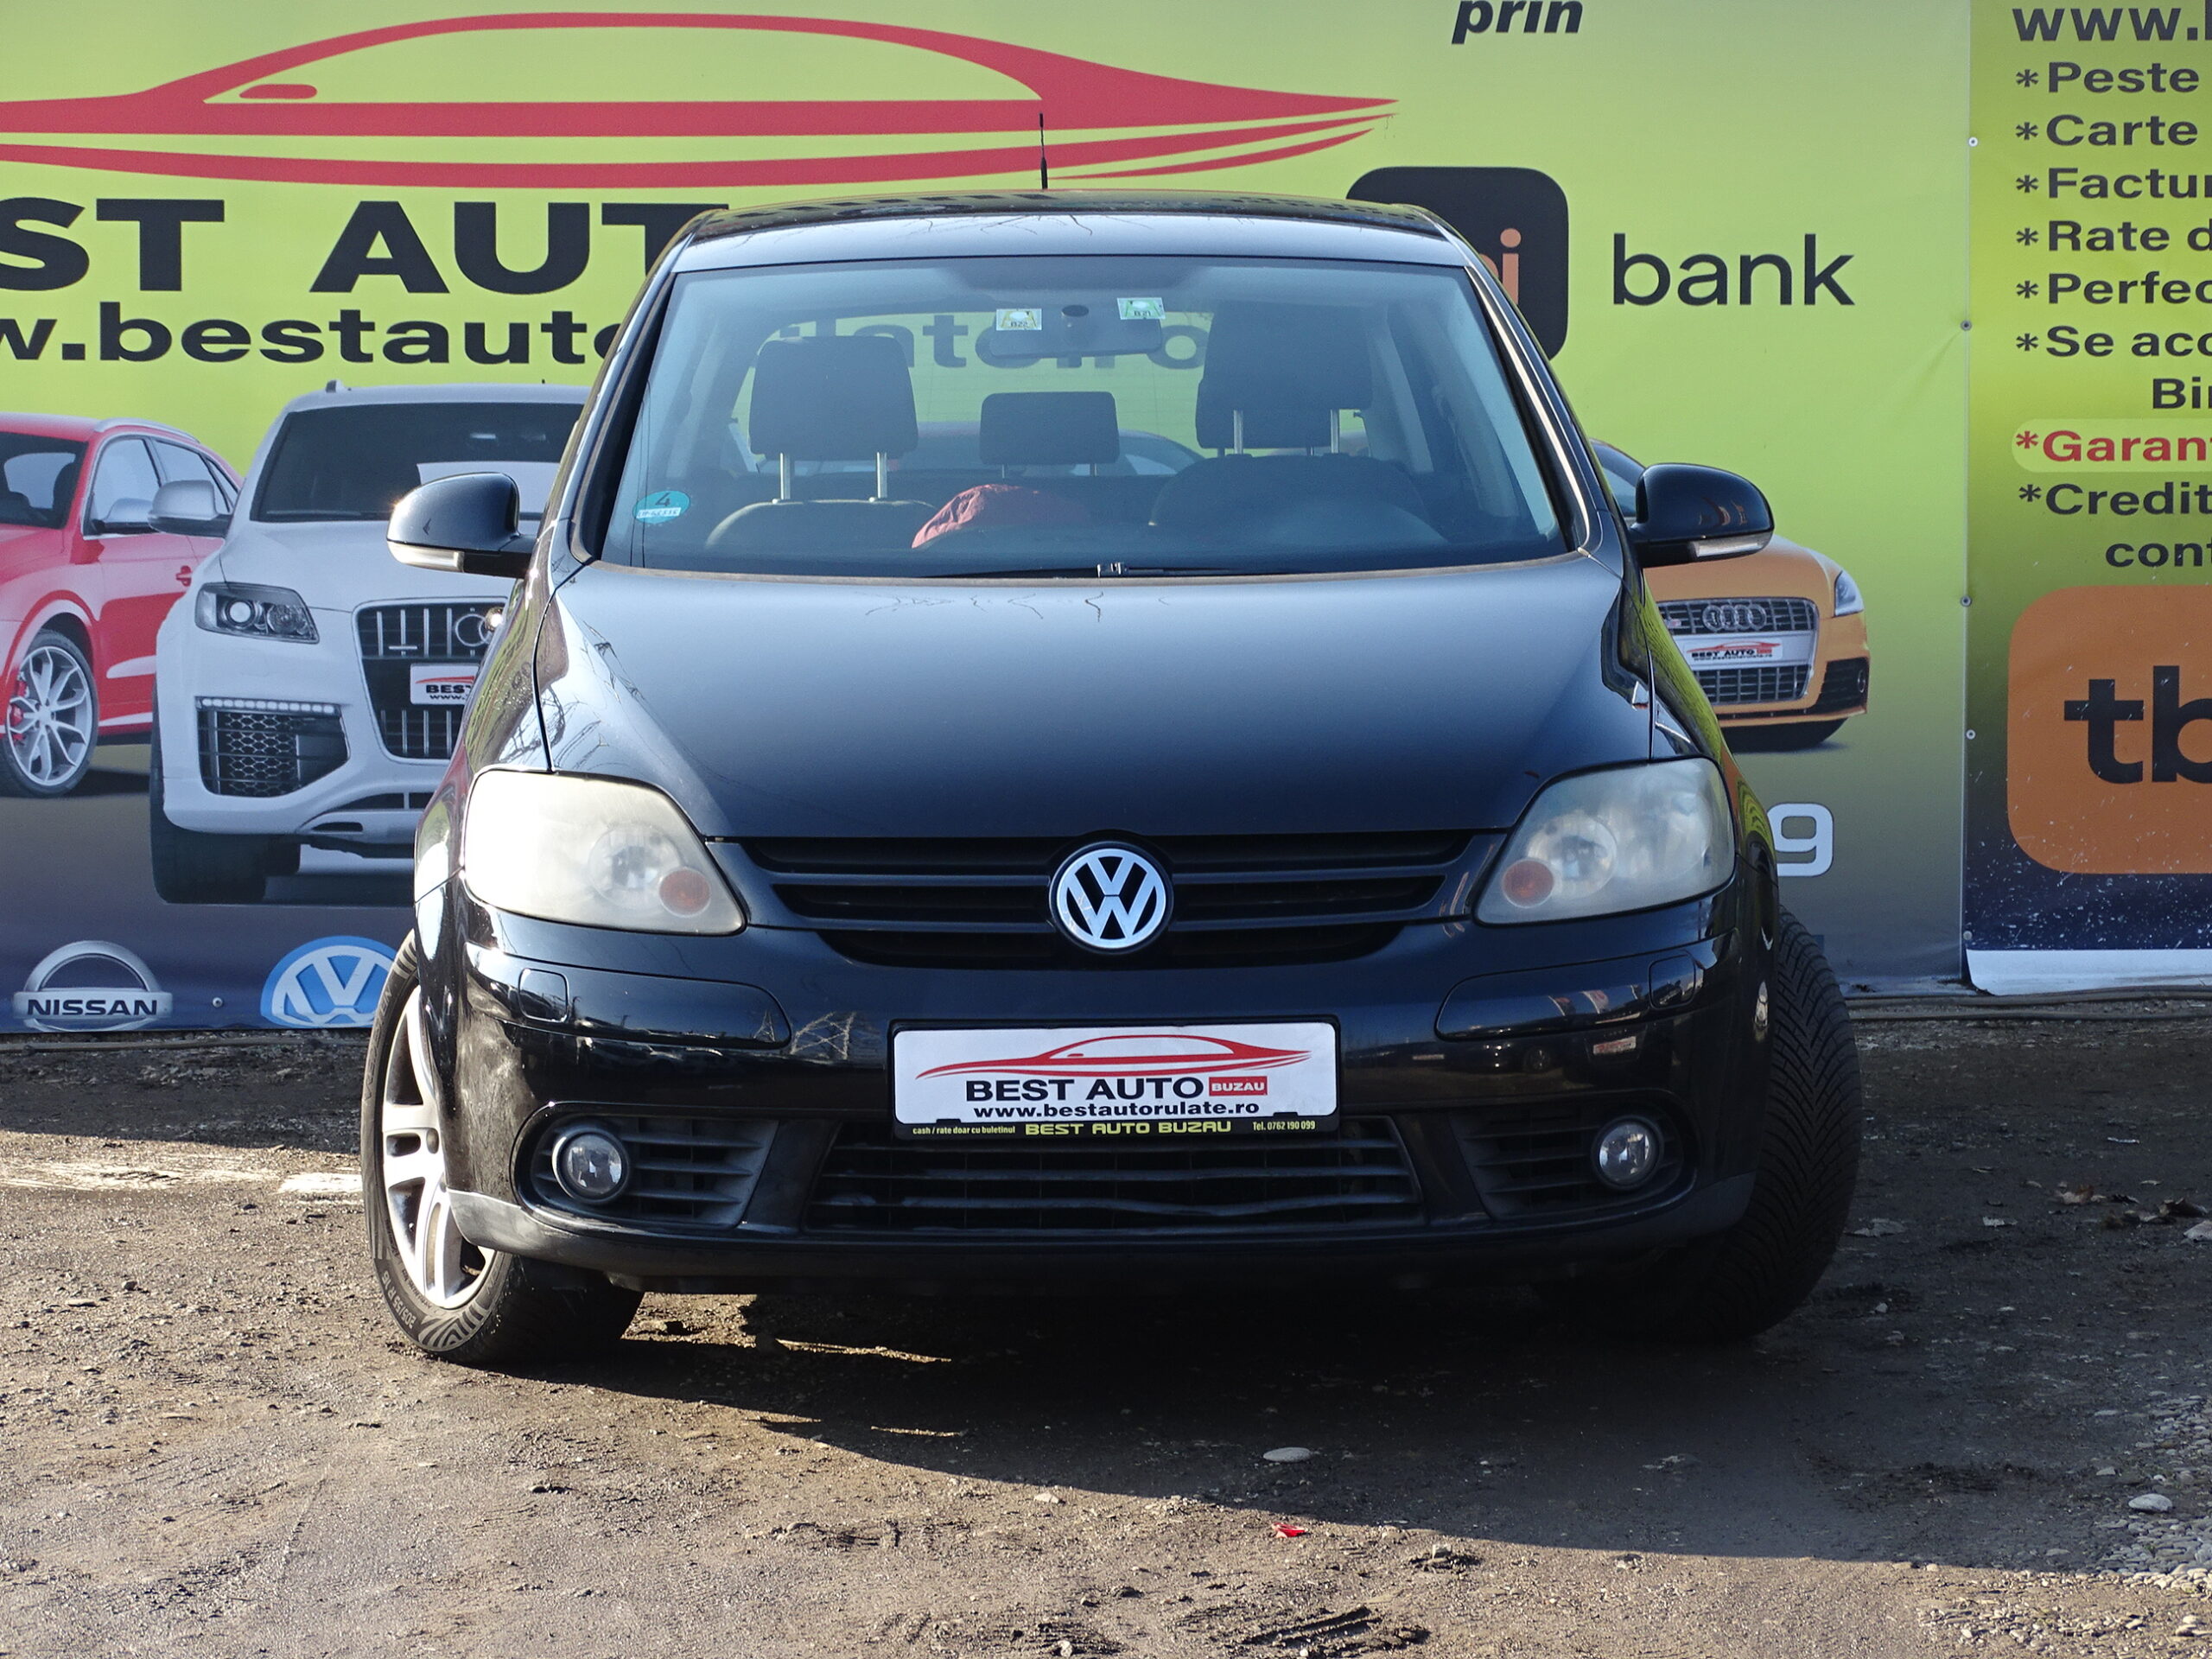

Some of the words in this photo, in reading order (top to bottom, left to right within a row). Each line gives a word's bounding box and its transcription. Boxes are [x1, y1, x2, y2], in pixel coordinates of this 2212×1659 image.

[1452, 0, 1583, 45] prin
[2012, 0, 2212, 41] www.
[2016, 168, 2212, 199] Factu
[1612, 232, 1857, 307] bank
[2152, 376, 2212, 409] Bi
[2016, 429, 2212, 462] Garan
[655, 492, 671, 506] 4
[27, 999, 157, 1015] NISSAN
[966, 1079, 1075, 1102] BEST
[1085, 1077, 1205, 1101] AUTO
[1211, 1081, 1265, 1092] BUZAU
[973, 1101, 1260, 1118] www.bestautorulate.ro
[912, 1127, 931, 1135] cash
[936, 1126, 952, 1135] rate
[952, 1125, 969, 1135] doar
[981, 1125, 1015, 1135] buletinul
[1025, 1122, 1084, 1135] BEST
[1091, 1122, 1151, 1135] AUTO
[1158, 1121, 1232, 1135] BUZAU
[1253, 1122, 1266, 1131] Tel.
